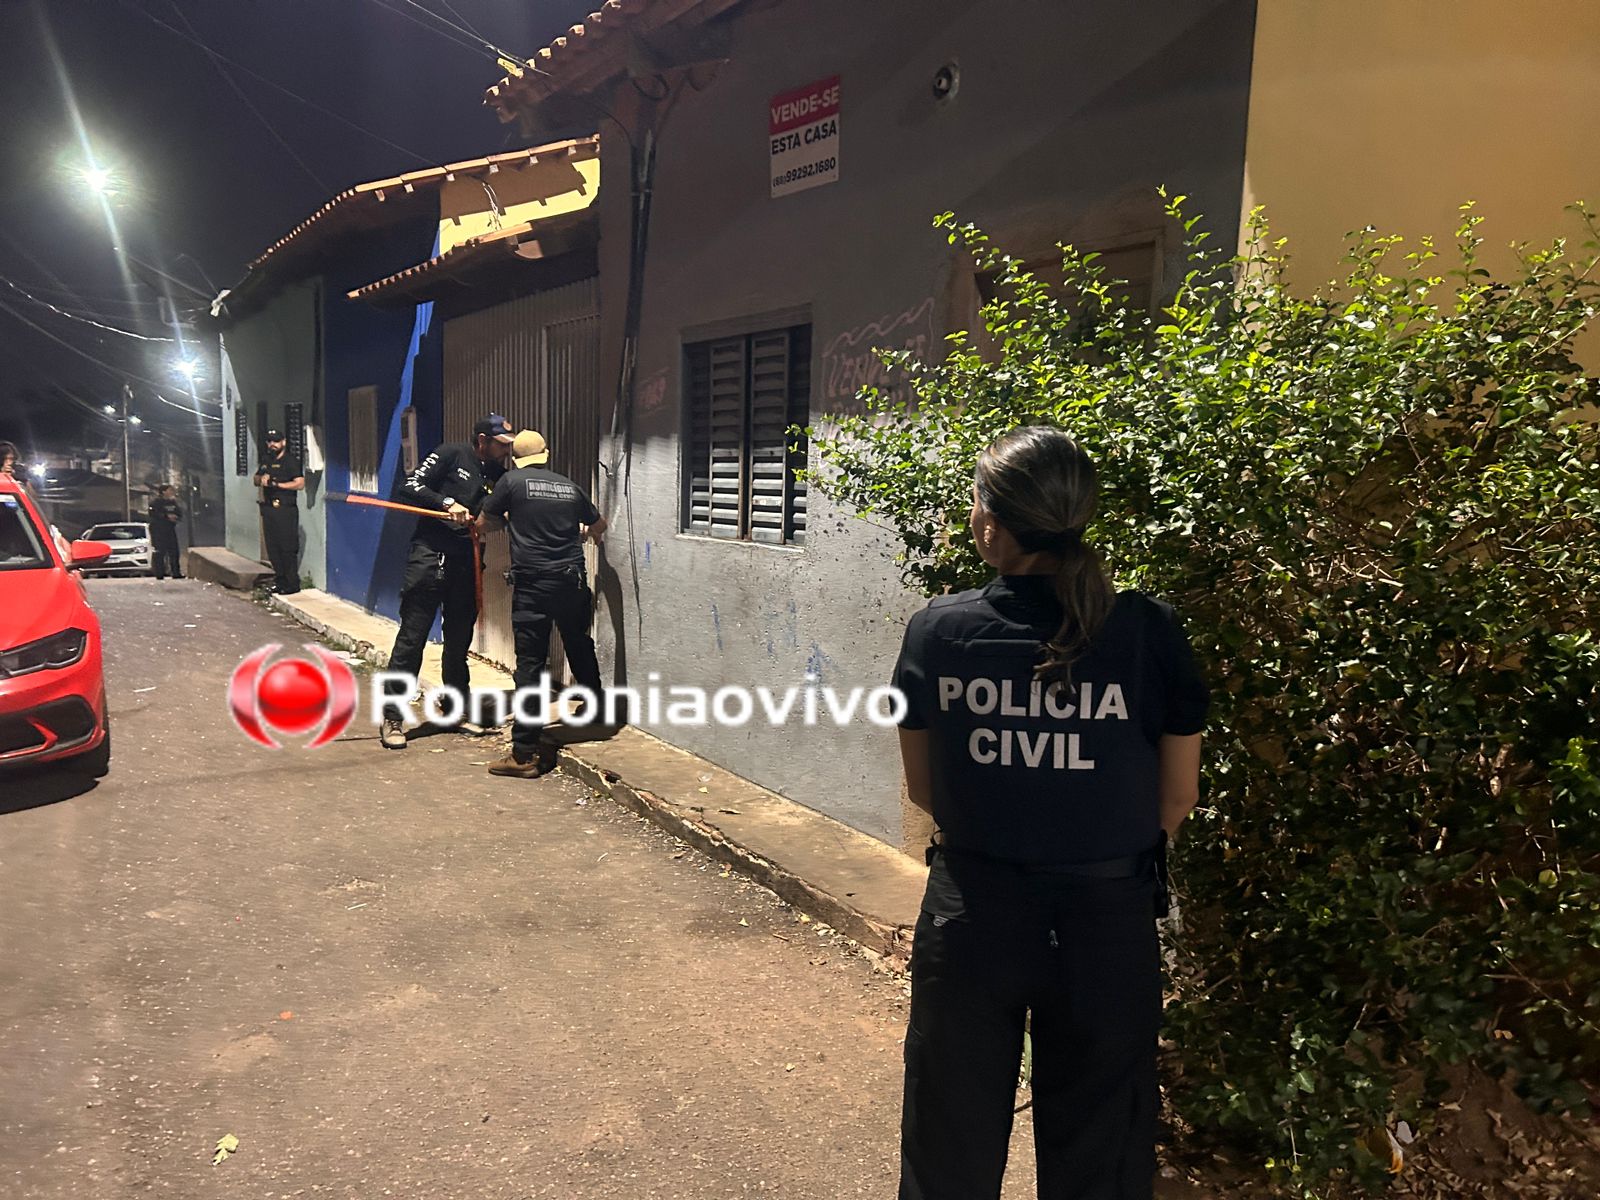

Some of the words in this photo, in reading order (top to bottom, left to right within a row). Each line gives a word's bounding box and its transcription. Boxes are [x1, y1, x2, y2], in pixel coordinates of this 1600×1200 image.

[771, 85, 840, 124] VENDE-SE
[772, 132, 801, 155] ESTA
[804, 120, 837, 144] CASA
[968, 728, 1095, 770] CIVIL
